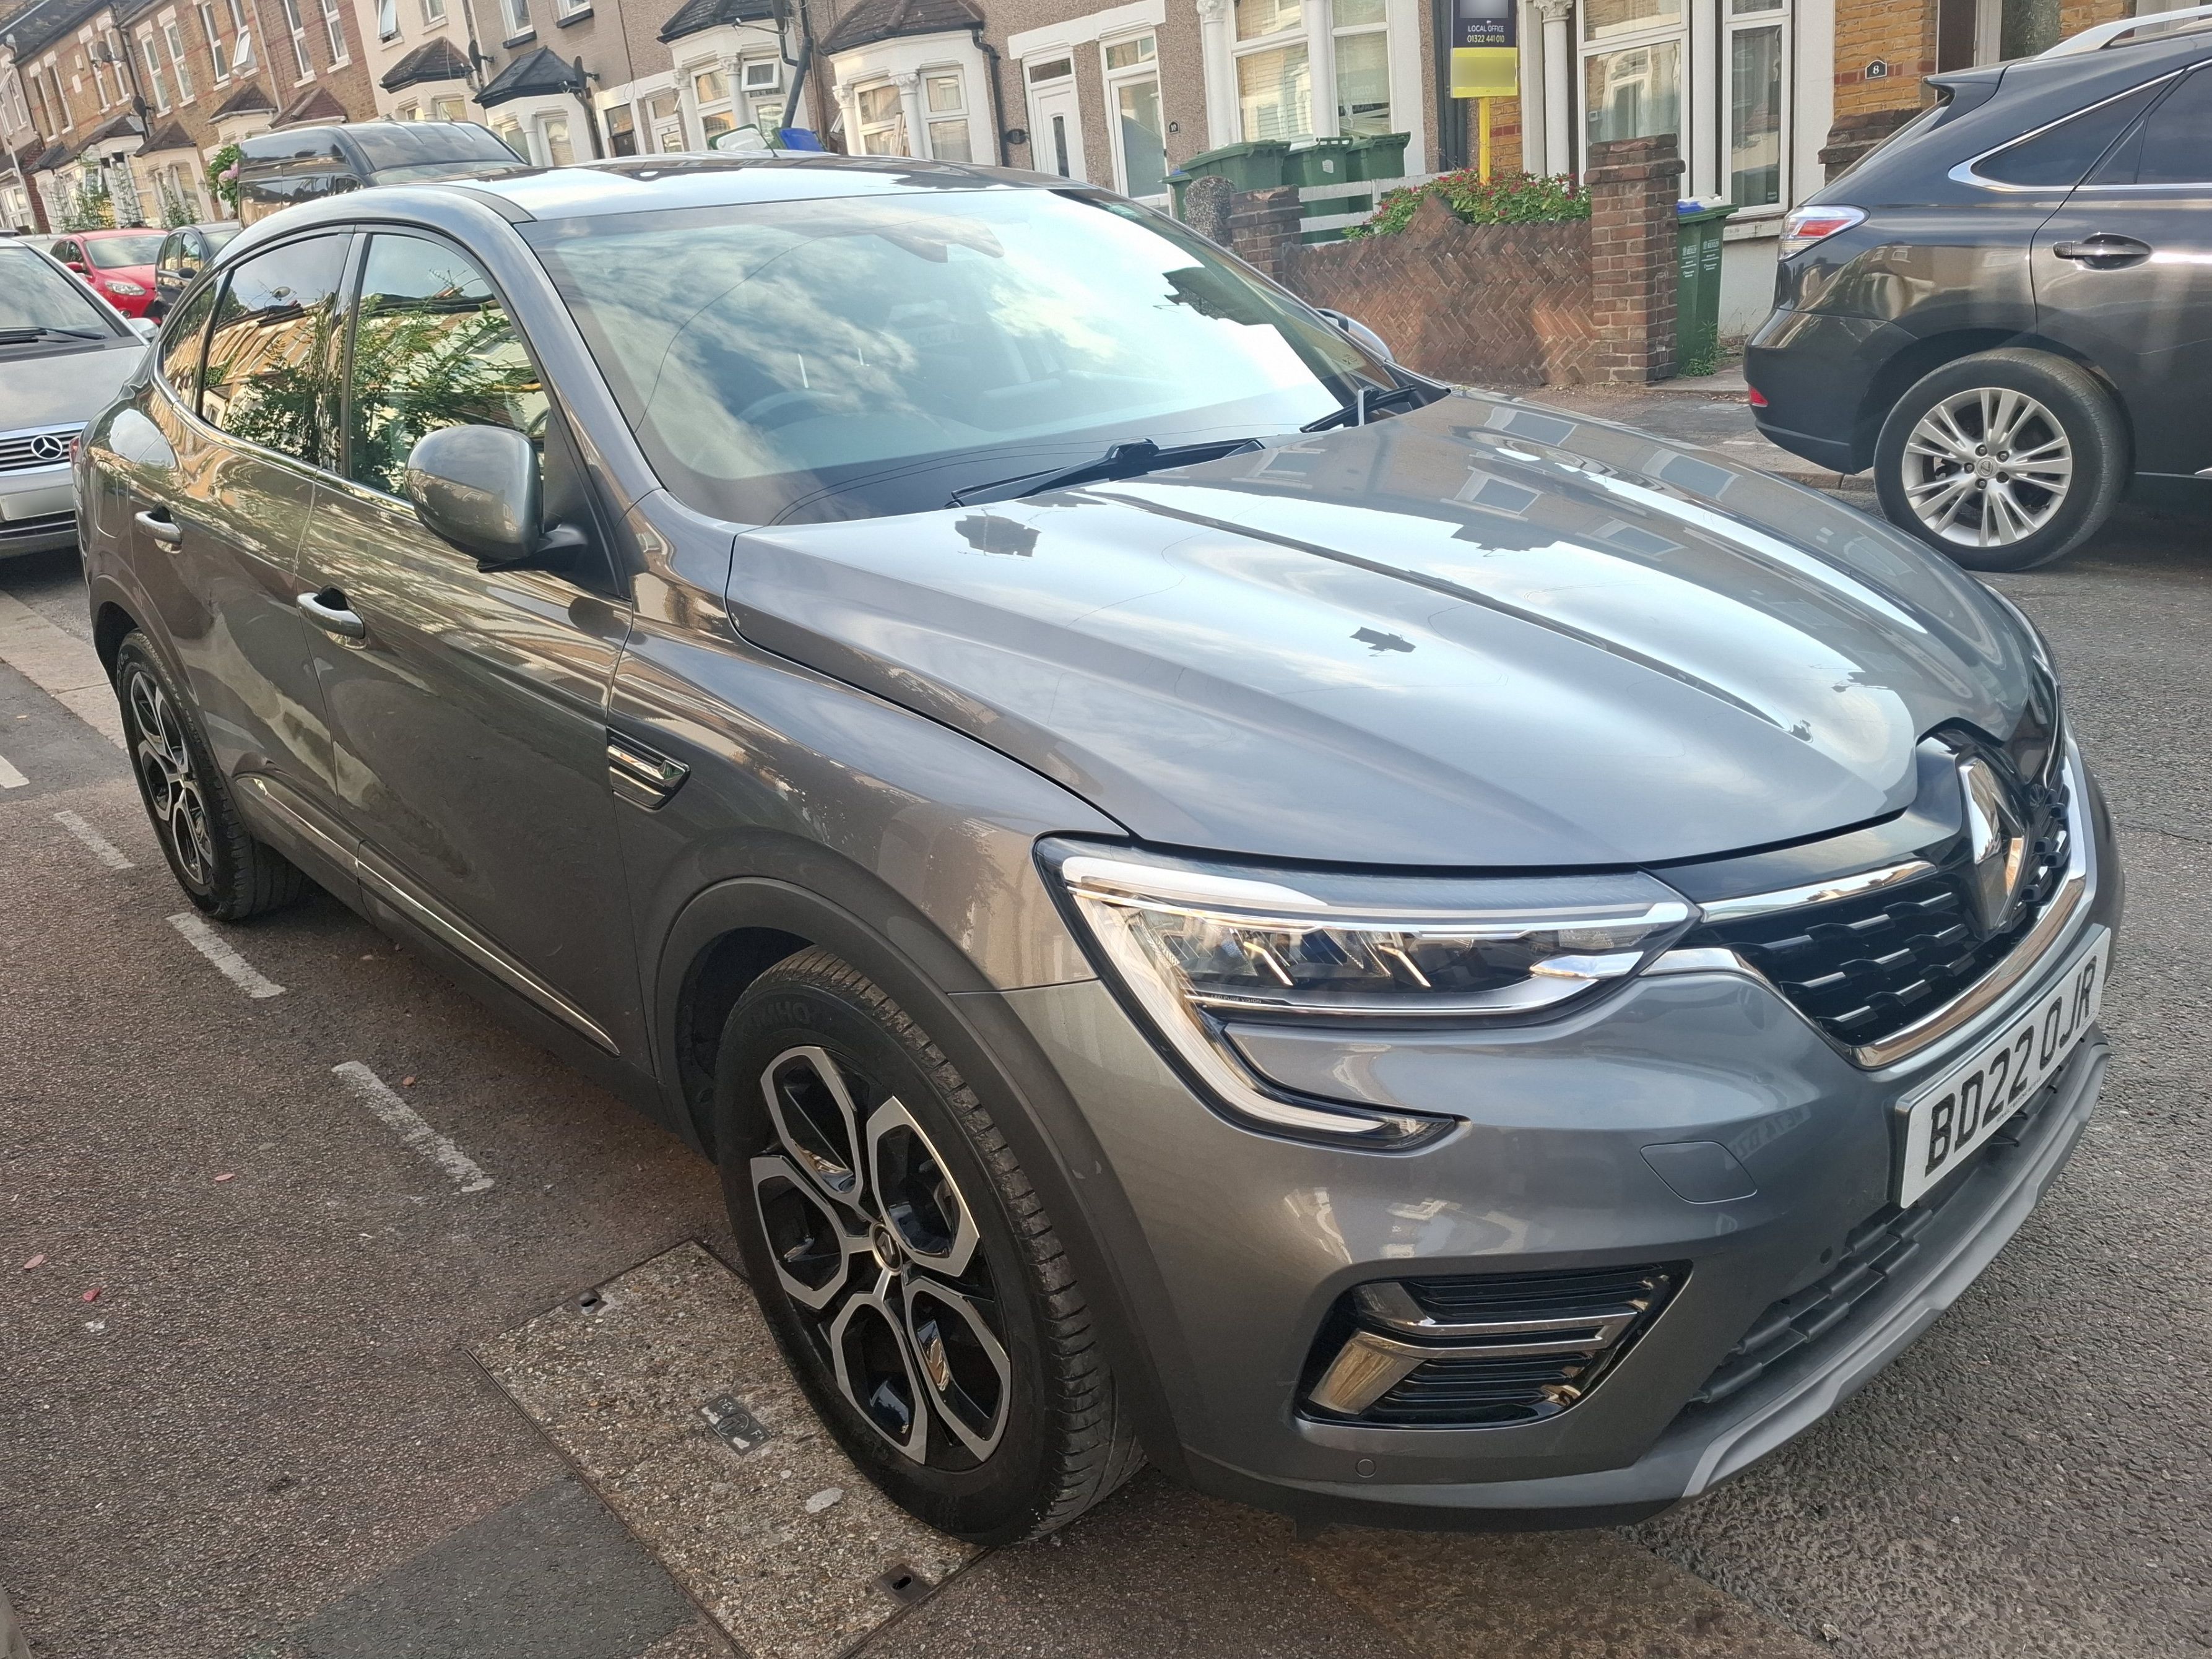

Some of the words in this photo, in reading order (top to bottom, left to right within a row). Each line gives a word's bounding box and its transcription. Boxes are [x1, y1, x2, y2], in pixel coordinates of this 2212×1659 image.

[1467, 35, 1485, 43] 01322
[1486, 35, 1495, 43] 441
[1496, 35, 1505, 43] 010
[1873, 65, 1880, 74] 8
[1924, 1024, 2035, 1179] BD22
